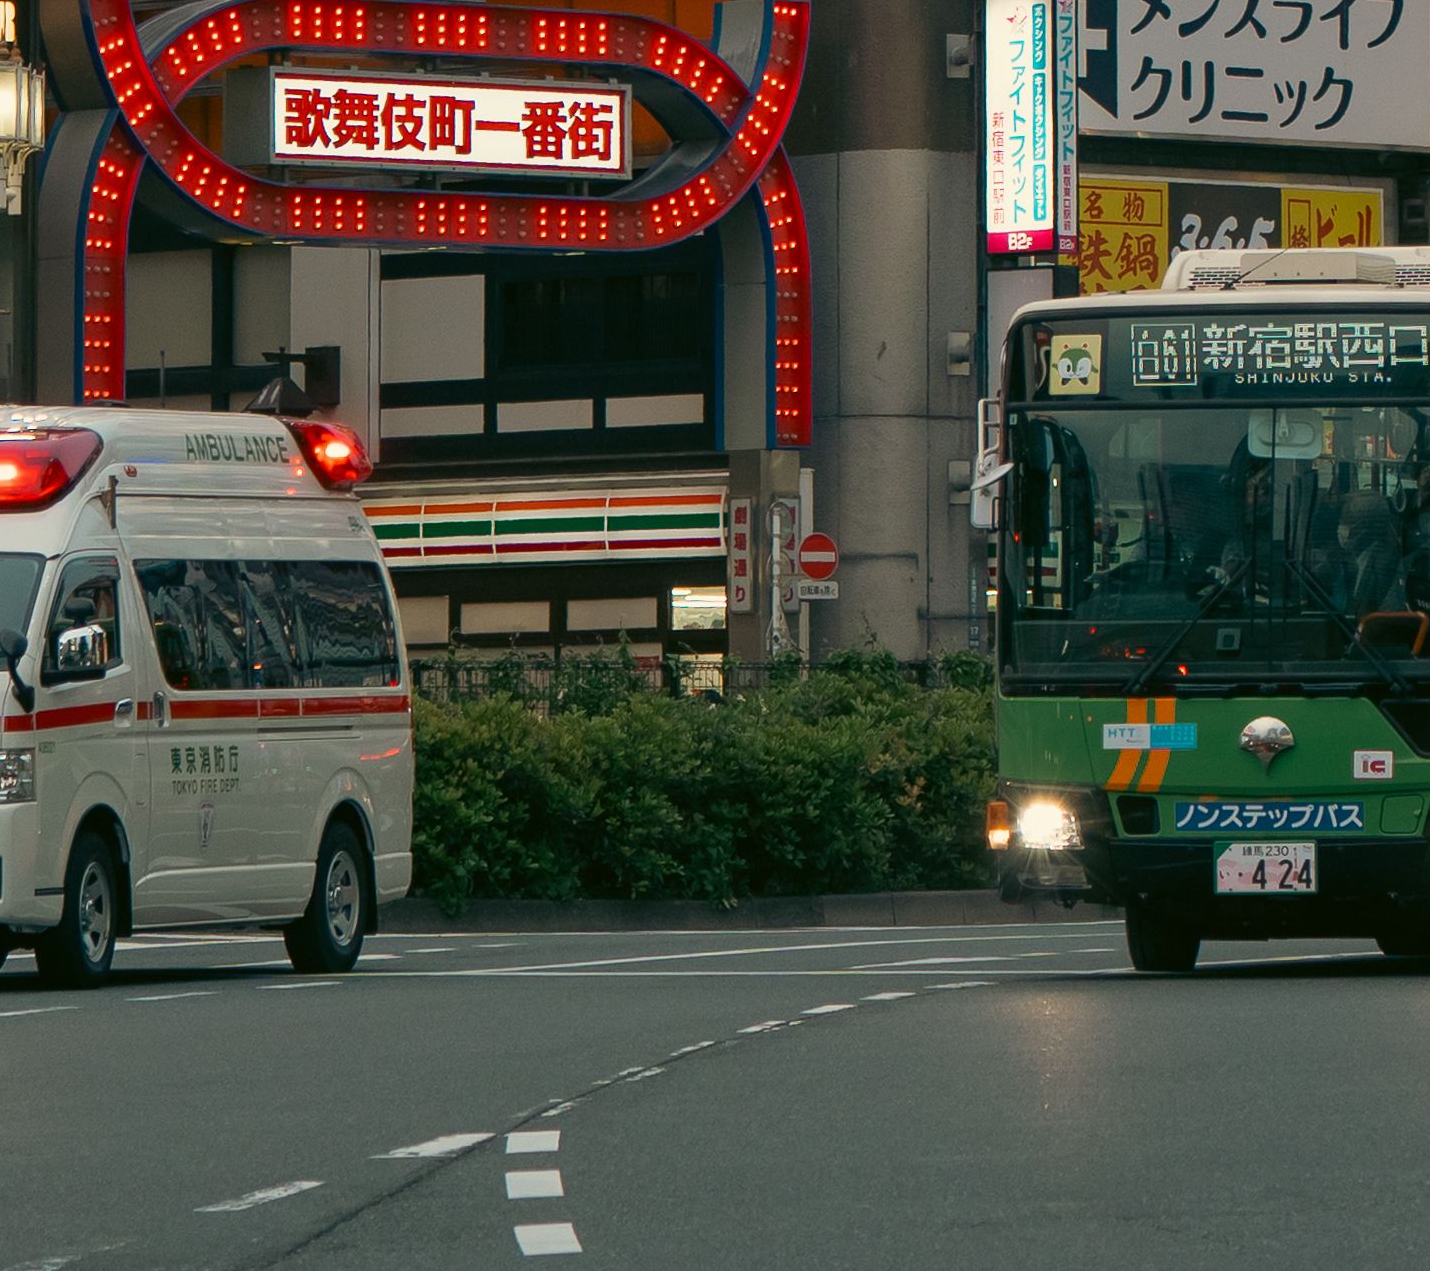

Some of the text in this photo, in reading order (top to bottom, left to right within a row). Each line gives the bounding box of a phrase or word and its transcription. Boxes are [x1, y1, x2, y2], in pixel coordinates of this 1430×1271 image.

[1059, 15, 1074, 161] ファイトフィット
[1130, 60, 1356, 130] クリニック
[285, 89, 612, 162] 歌舞伎町一番街
[1009, 40, 1027, 223] ファイトフィット
[992, 112, 1005, 225] 新宿東口駅前
[1084, 192, 1145, 222] 名物
[1008, 233, 1032, 250] B2F
[1202, 323, 1429, 369] 新宿駅西口
[1235, 372, 1392, 384] SHINJUKU STA.
[184, 433, 289, 462] AMBULANCE
[734, 505, 747, 602] 劇場通り
[1108, 728, 1135, 738] HTT
[171, 745, 238, 774] 東京消防庁
[172, 778, 218, 794] TOKYO FIRE
[1177, 804, 1363, 829] ノンステップバス
[1265, 846, 1289, 856] 230
